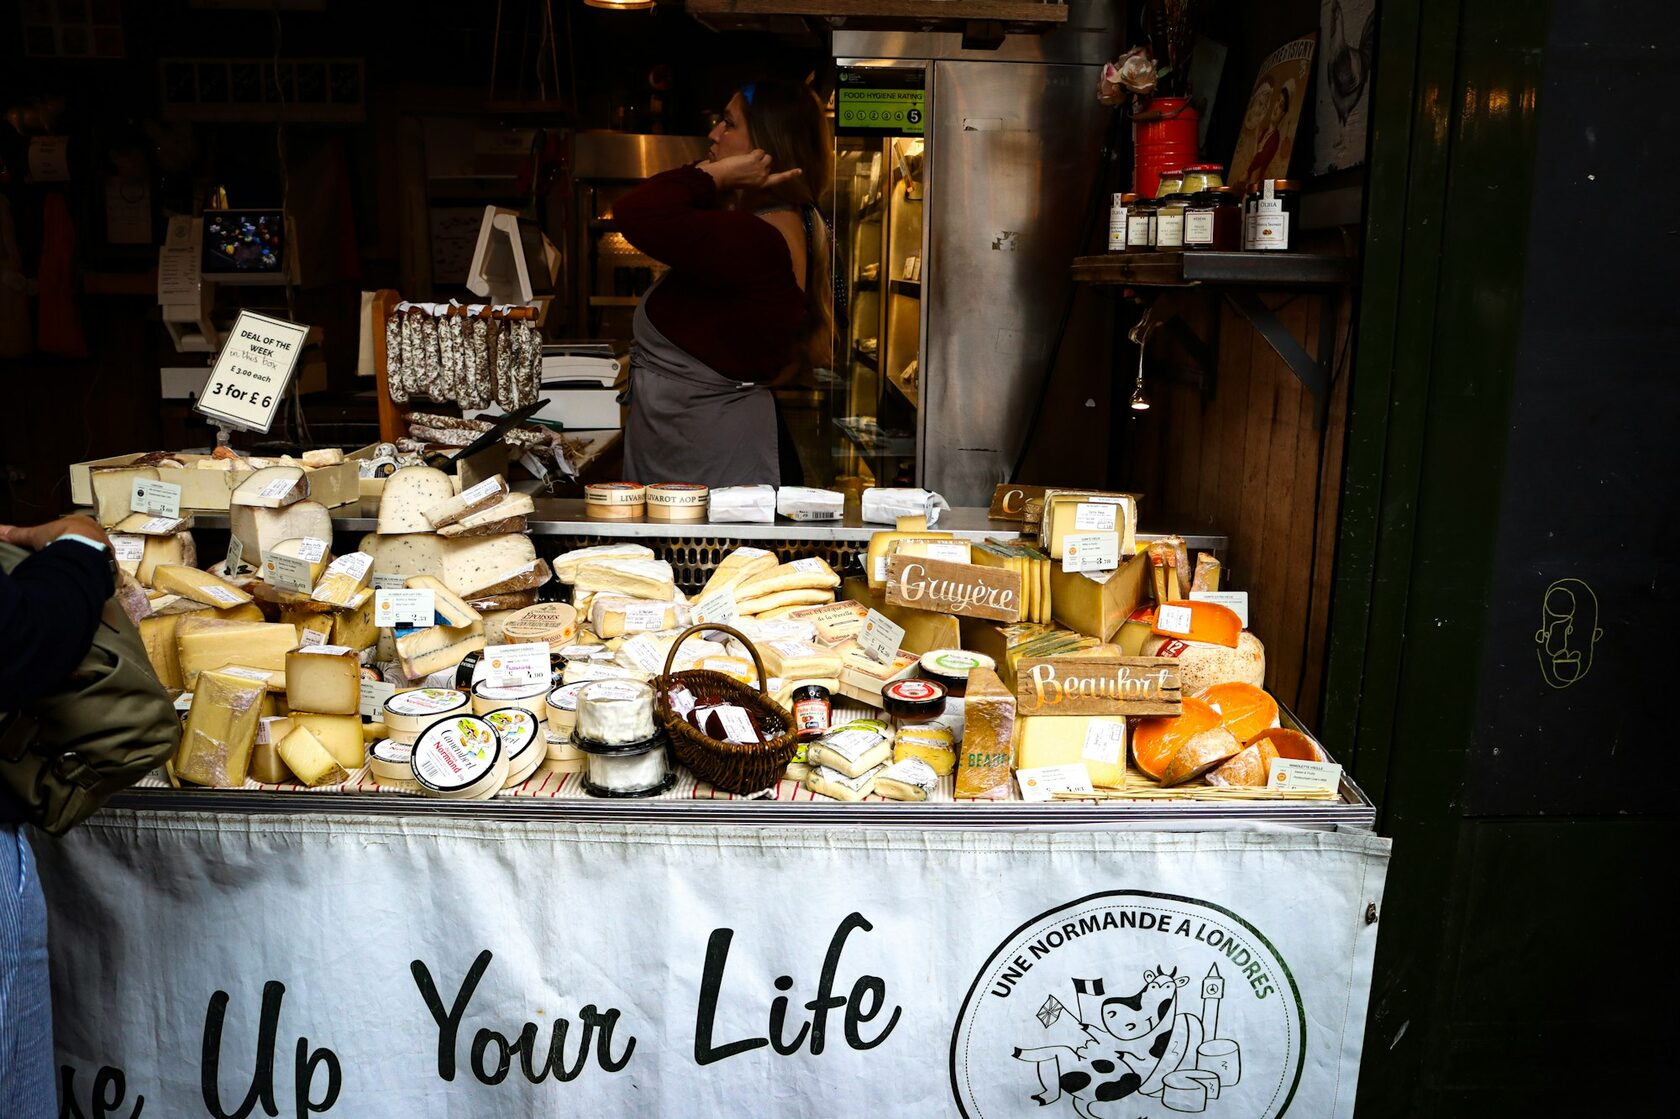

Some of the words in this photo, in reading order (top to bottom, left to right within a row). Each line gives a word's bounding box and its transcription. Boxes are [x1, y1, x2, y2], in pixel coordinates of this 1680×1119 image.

[910, 110, 919, 122] 5
[240, 330, 262, 343] DEAL
[263, 336, 276, 346] OF
[275, 340, 292, 350] THE
[250, 344, 275, 358] WEEK
[229, 350, 240, 358] in
[241, 350, 258, 364] this
[262, 356, 279, 371] box
[236, 366, 252, 377] 3.00
[252, 372, 272, 383] each
[212, 382, 224, 395] 3
[225, 383, 248, 400] for
[249, 392, 260, 405] £
[261, 396, 272, 408] 6
[900, 563, 1014, 612] Gruyère
[1166, 640, 1183, 654] 12
[1024, 663, 1174, 712] Beaufort
[433, 741, 463, 774] Normand
[440, 729, 478, 770] Camembert
[991, 954, 1033, 1000] UNE
[1030, 910, 1172, 958] NORMANDE
[1174, 919, 1191, 937] A
[1194, 923, 1275, 1001] LONDRES
[201, 980, 342, 1119] Up
[410, 949, 636, 1086] Your
[694, 912, 902, 1066] Life
